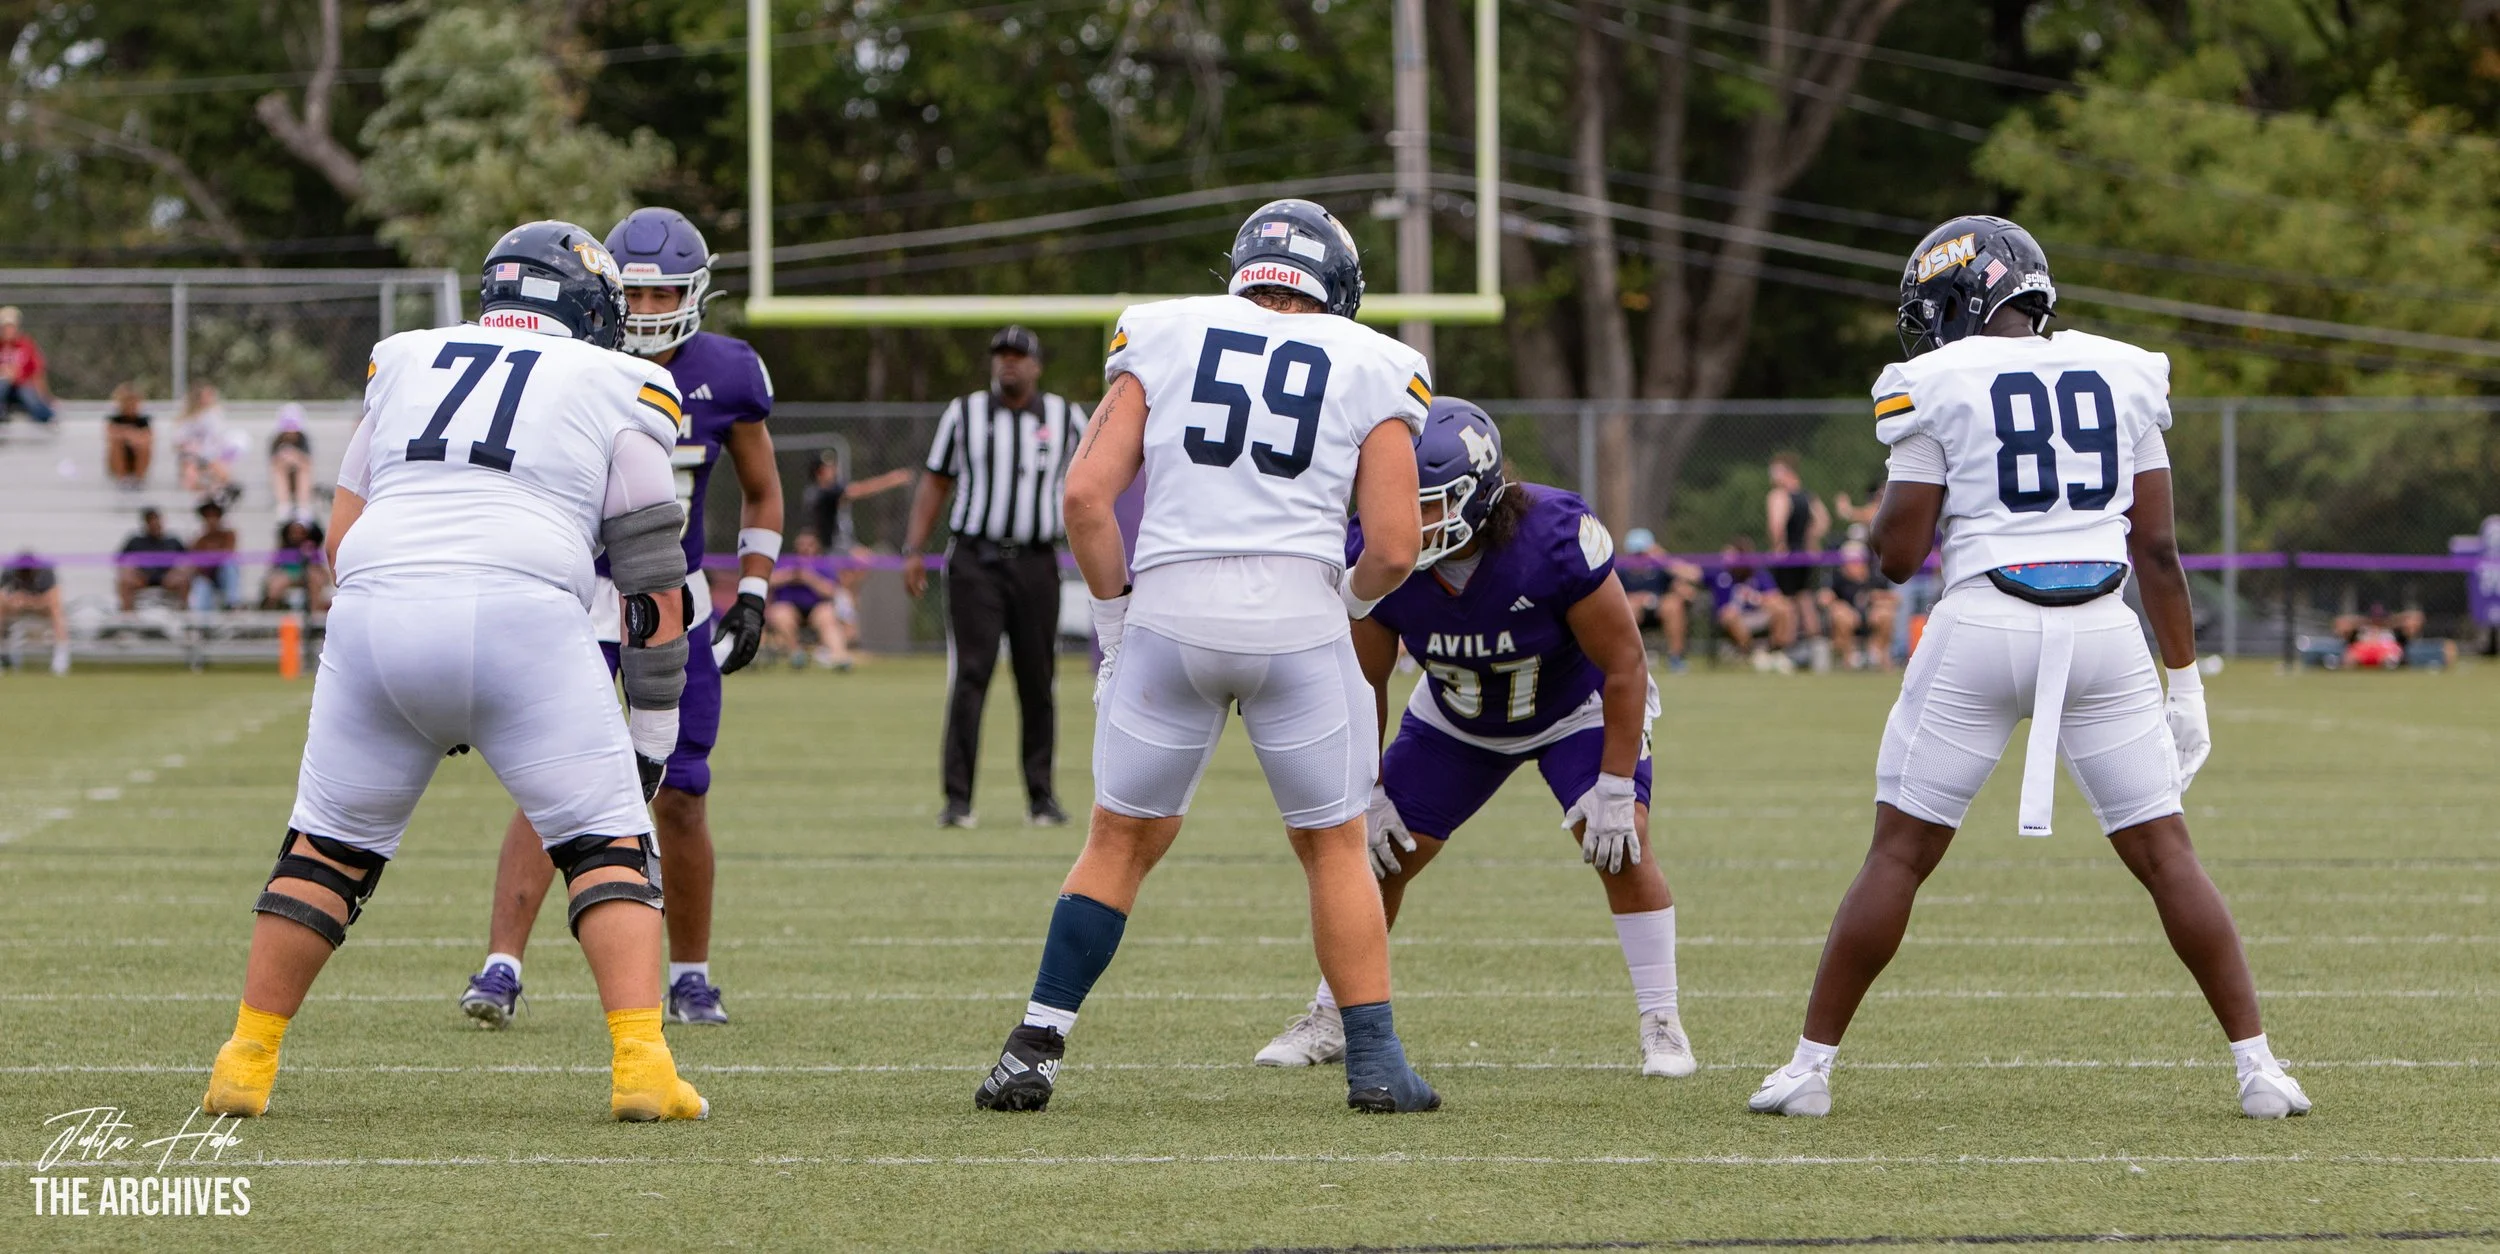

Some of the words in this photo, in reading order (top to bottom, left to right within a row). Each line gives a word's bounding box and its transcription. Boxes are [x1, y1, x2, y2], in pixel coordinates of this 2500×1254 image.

[1241, 266, 1300, 285] Riddell
[1916, 234, 1977, 282] USM
[484, 315, 539, 330] Riddell
[405, 341, 542, 473] 71
[1183, 327, 1332, 479] 59
[1990, 370, 2119, 513] 89
[1426, 630, 1517, 659] AVILA
